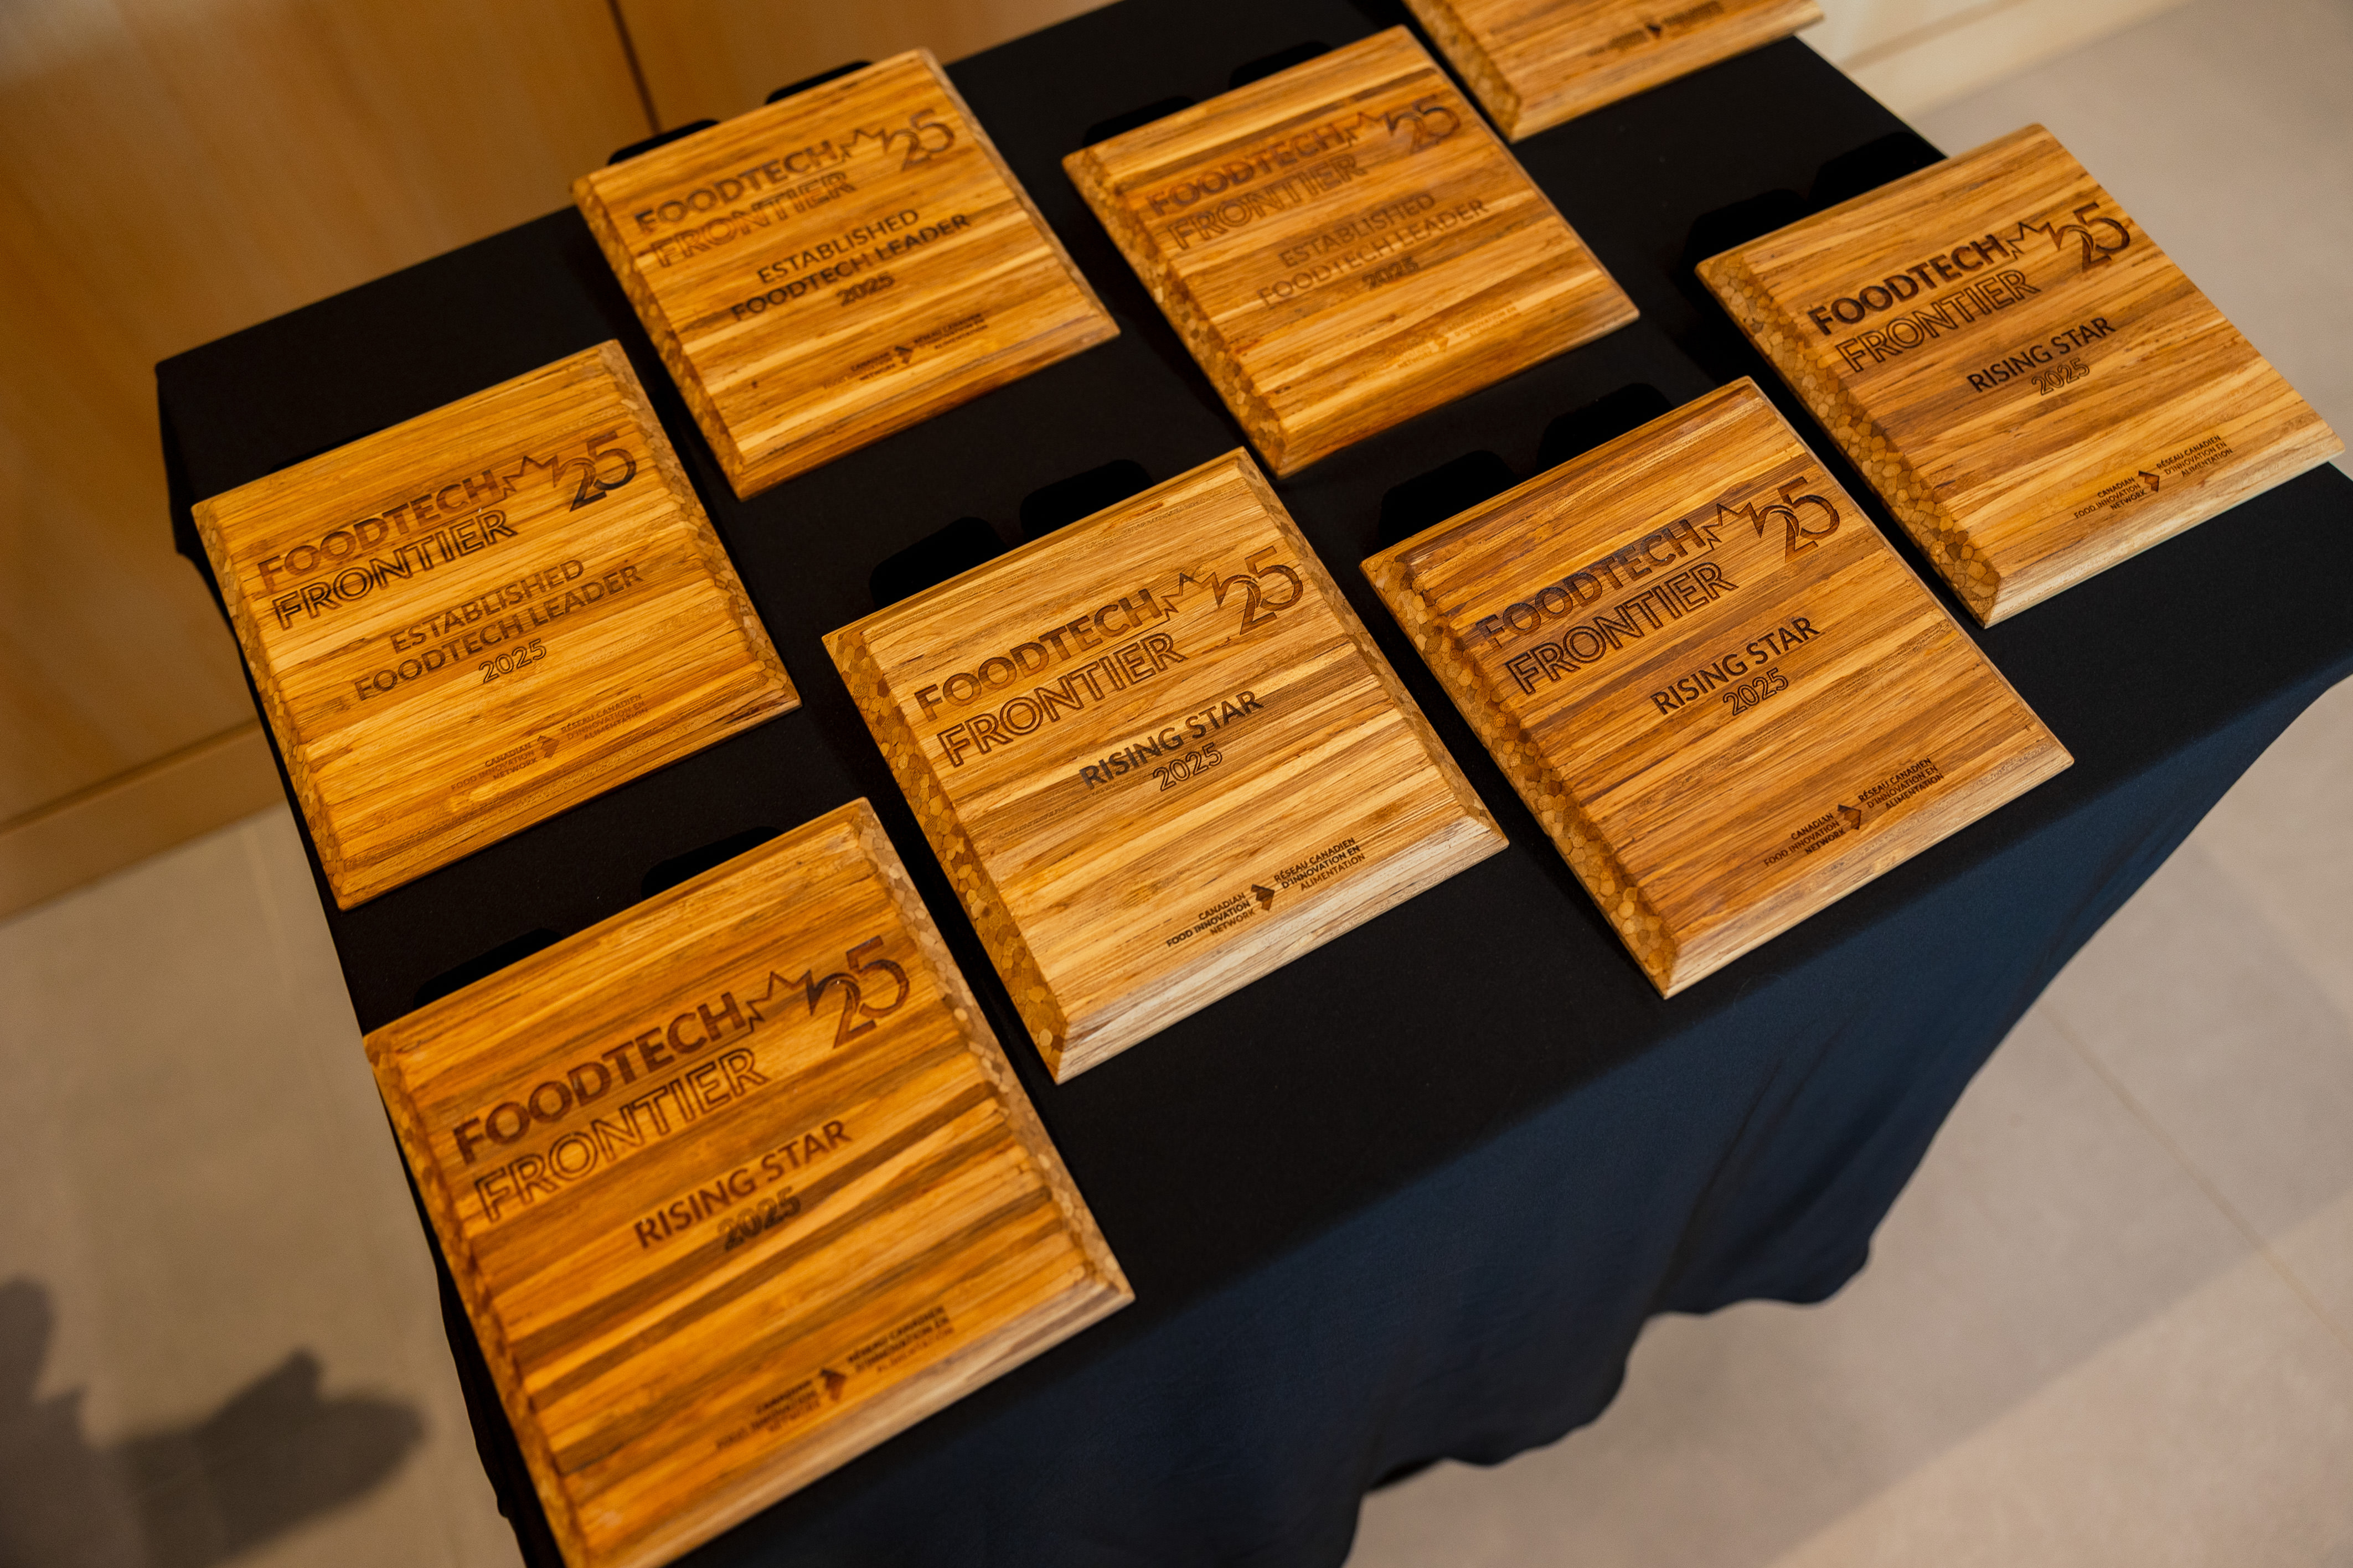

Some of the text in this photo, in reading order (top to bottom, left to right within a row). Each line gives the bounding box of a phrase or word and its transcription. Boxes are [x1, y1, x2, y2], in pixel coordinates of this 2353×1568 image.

[634, 139, 839, 234] FOODTECH
[1145, 124, 1348, 217] FOODTECH
[1168, 153, 1368, 250] FRONTIER
[651, 172, 857, 268] FRONTIER
[757, 208, 919, 284] ESTABLISHED
[1257, 199, 1488, 307] FOODTECH LEADER
[1278, 192, 1436, 268] ESTABLISHED
[730, 213, 971, 322] FOODTECH LEADER
[838, 272, 896, 307] 2025
[1807, 234, 2010, 336] FOODTECH
[1835, 268, 2041, 373] FRONTIER
[1965, 317, 2116, 394] RISING STAR
[2031, 358, 2091, 396] 2025
[2156, 435, 2221, 470] RÉSEAU CANADIEN
[2181, 448, 2233, 477] ALIMENTATION
[2214, 442, 2227, 451] EN
[2074, 484, 2141, 519] FOOD INNOVATION
[2097, 477, 2135, 498] CANADIAN
[2110, 490, 2146, 510] NETWORK
[257, 469, 501, 593] FOODTECH
[272, 509, 518, 631] FRONTIER
[1475, 519, 1704, 650] FOODTECH
[354, 565, 644, 701] FOODTECH LEADER
[391, 559, 585, 654] ESTABLISHED
[1505, 561, 1739, 696] FRONTIER
[478, 638, 548, 684] 2025
[914, 588, 1163, 722] FOODTECH
[1650, 616, 1821, 716] RISING STAR
[937, 632, 1189, 768] FRONTIER
[1723, 666, 1789, 717] 2025
[1079, 690, 1265, 791] RISING STAR
[1153, 742, 1224, 792] 2025
[1858, 757, 1932, 802] RÉSEAU CANADIEN
[1867, 765, 1938, 809] D'INNOVATION EN
[1886, 773, 1944, 810] ALIMENTATION
[1274, 837, 1355, 883] RÉSEAU CANADIEN
[1763, 820, 1840, 867] FOOD INNOVATION
[1791, 813, 1834, 840] CANADIAN
[1804, 827, 1846, 855] NETWORK
[1281, 845, 1360, 889] D'INNOVATION EN
[1301, 853, 1365, 891] ALIMENTATION
[1166, 901, 1251, 948] FOOD INNOVATION
[1199, 892, 1246, 920] CANADIAN
[1210, 908, 1256, 935] NETWORK
[452, 992, 746, 1166] FOODTECH
[474, 1047, 771, 1223] FRONTIER
[633, 1119, 853, 1250] RISING STAR
[718, 1186, 802, 1252] 2025
